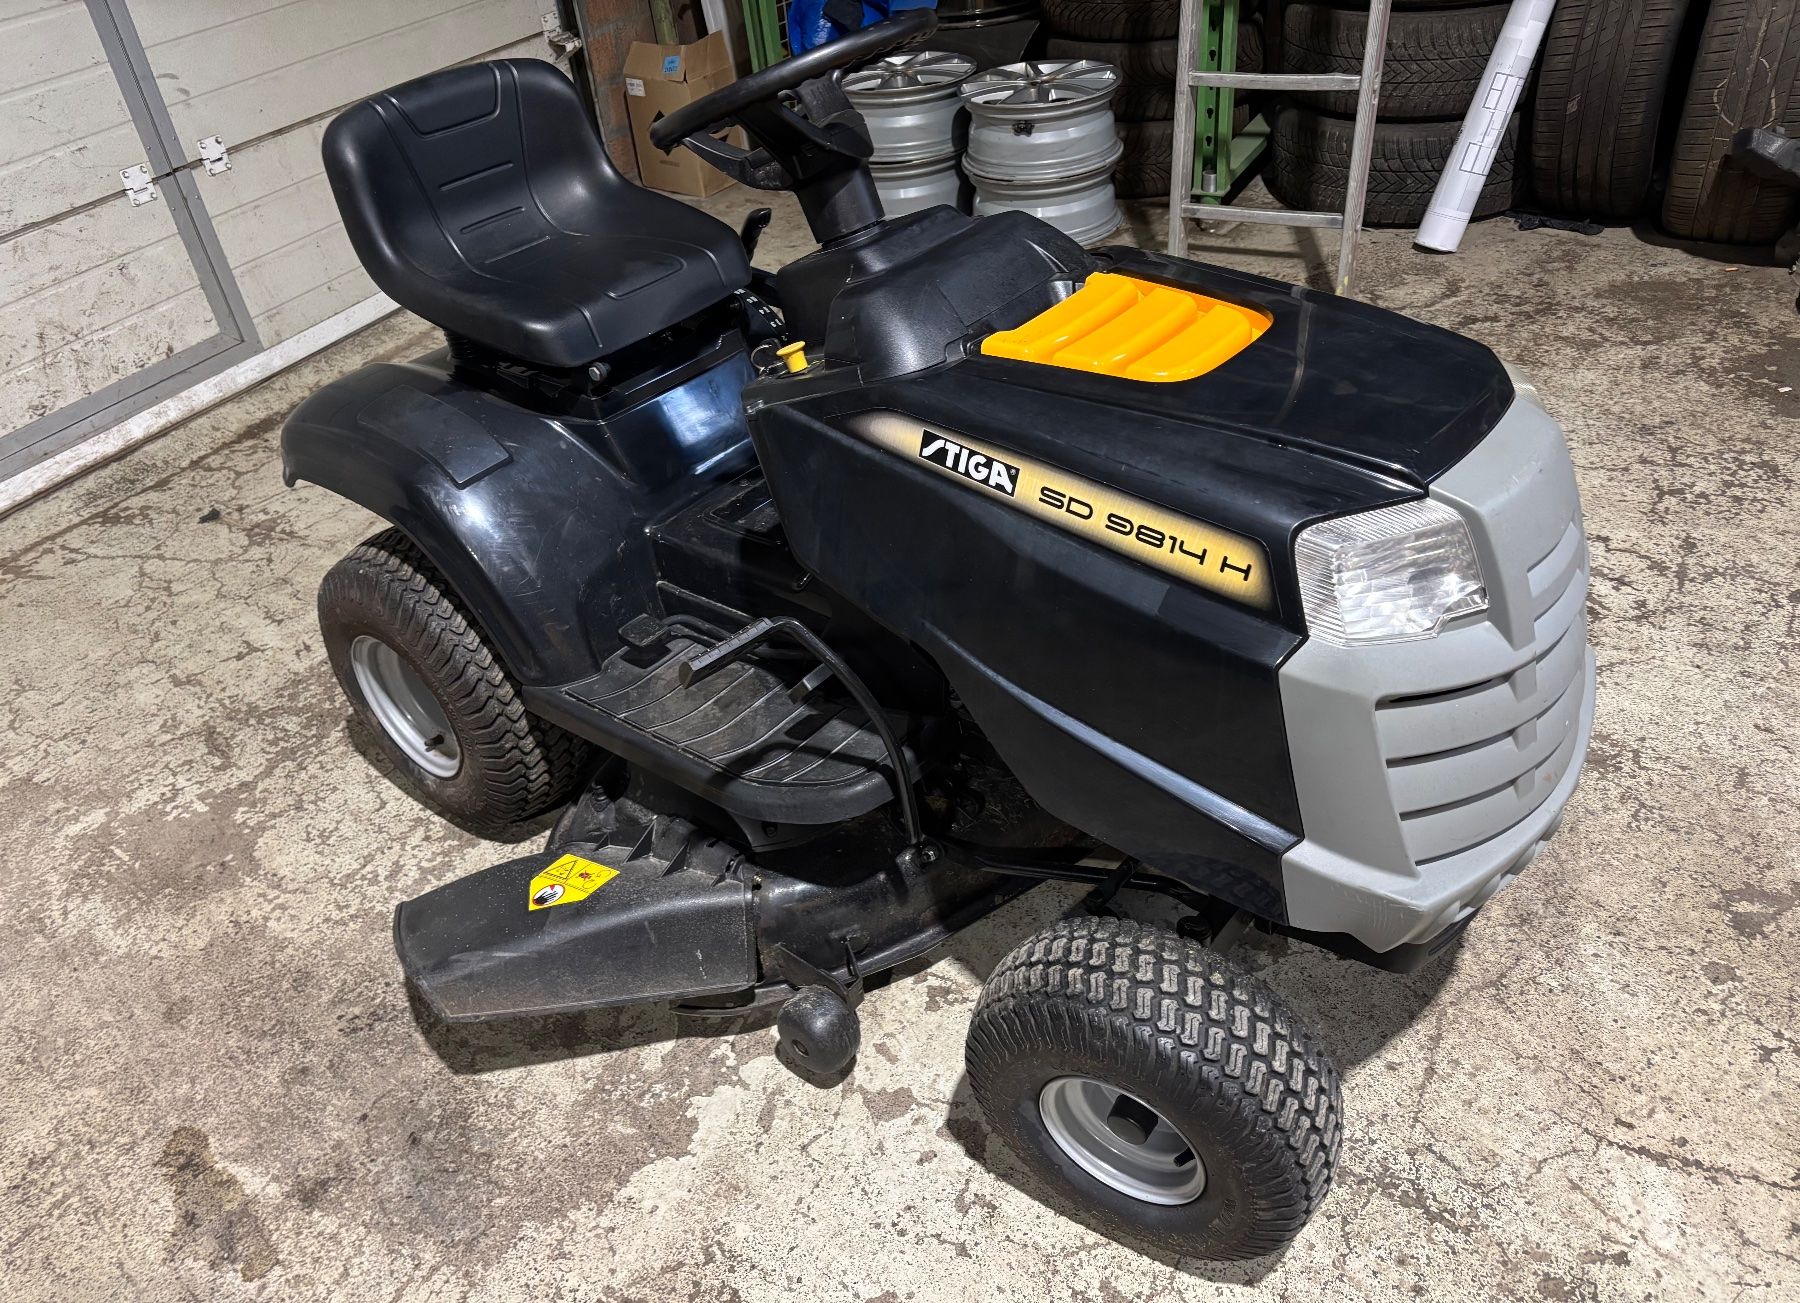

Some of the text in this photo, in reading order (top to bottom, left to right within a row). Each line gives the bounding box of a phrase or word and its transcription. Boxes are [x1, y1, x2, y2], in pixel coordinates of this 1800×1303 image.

[922, 438, 1252, 581] STIGA SD 9814 H
